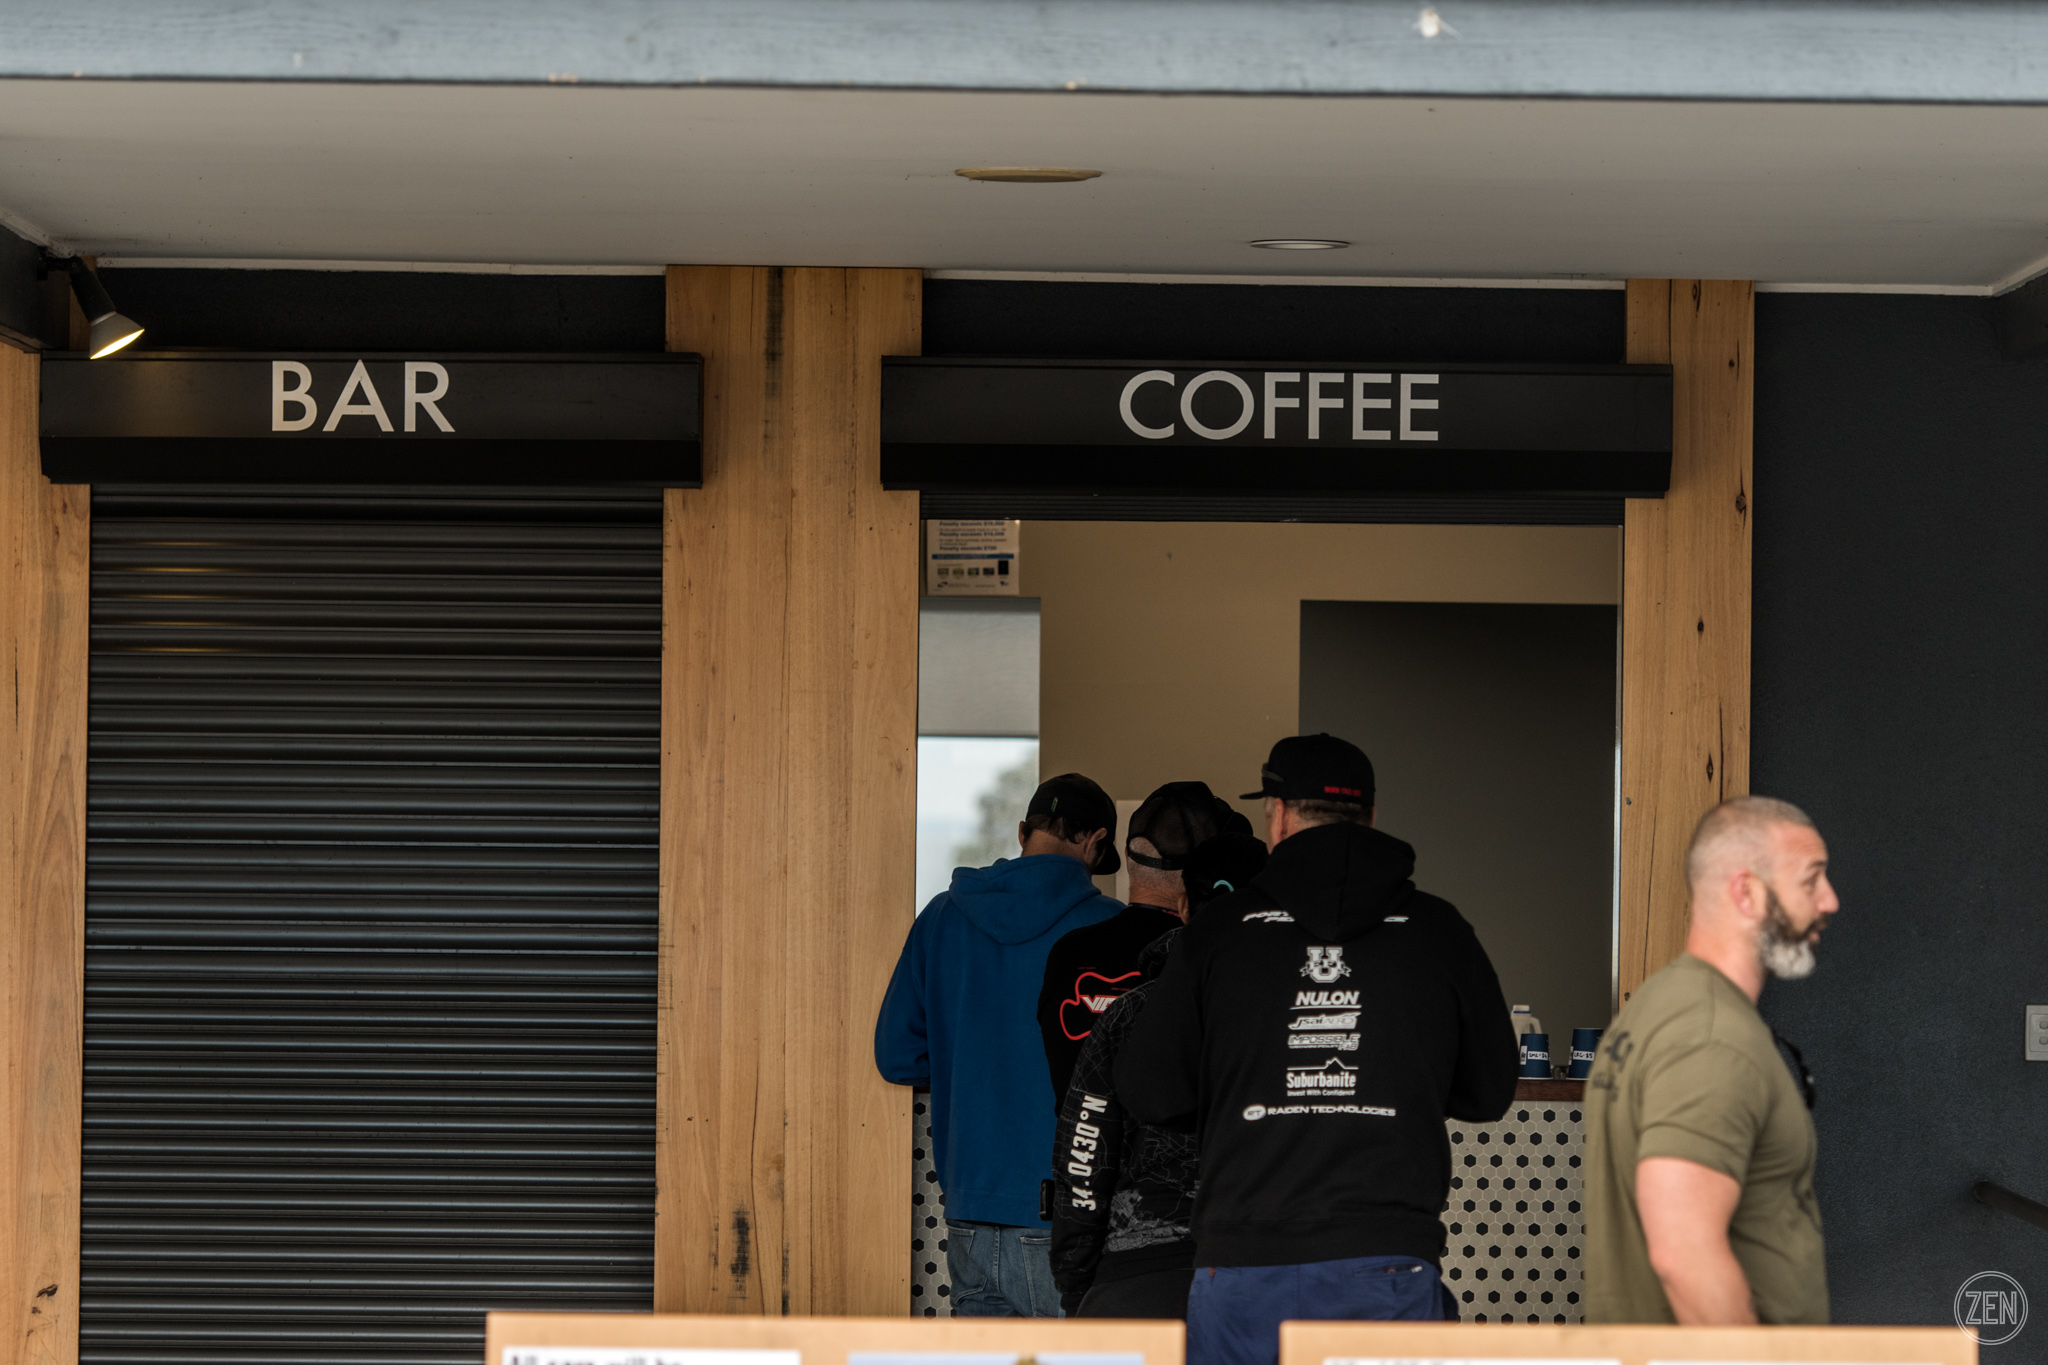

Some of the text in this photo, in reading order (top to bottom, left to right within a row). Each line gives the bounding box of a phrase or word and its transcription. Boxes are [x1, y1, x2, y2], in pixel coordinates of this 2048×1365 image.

[271, 359, 456, 433] BAR
[1118, 369, 1440, 442] COFFEE
[1295, 991, 1361, 1006] NULON
[1289, 1035, 1359, 1045] IMPOSSIBLE
[1286, 1072, 1357, 1089] Suburbanite
[1287, 1088, 1356, 1097] Invest With Confidence
[1267, 1105, 1310, 1116] RAIDEN
[1310, 1105, 1397, 1118] TECHNOLOGIES
